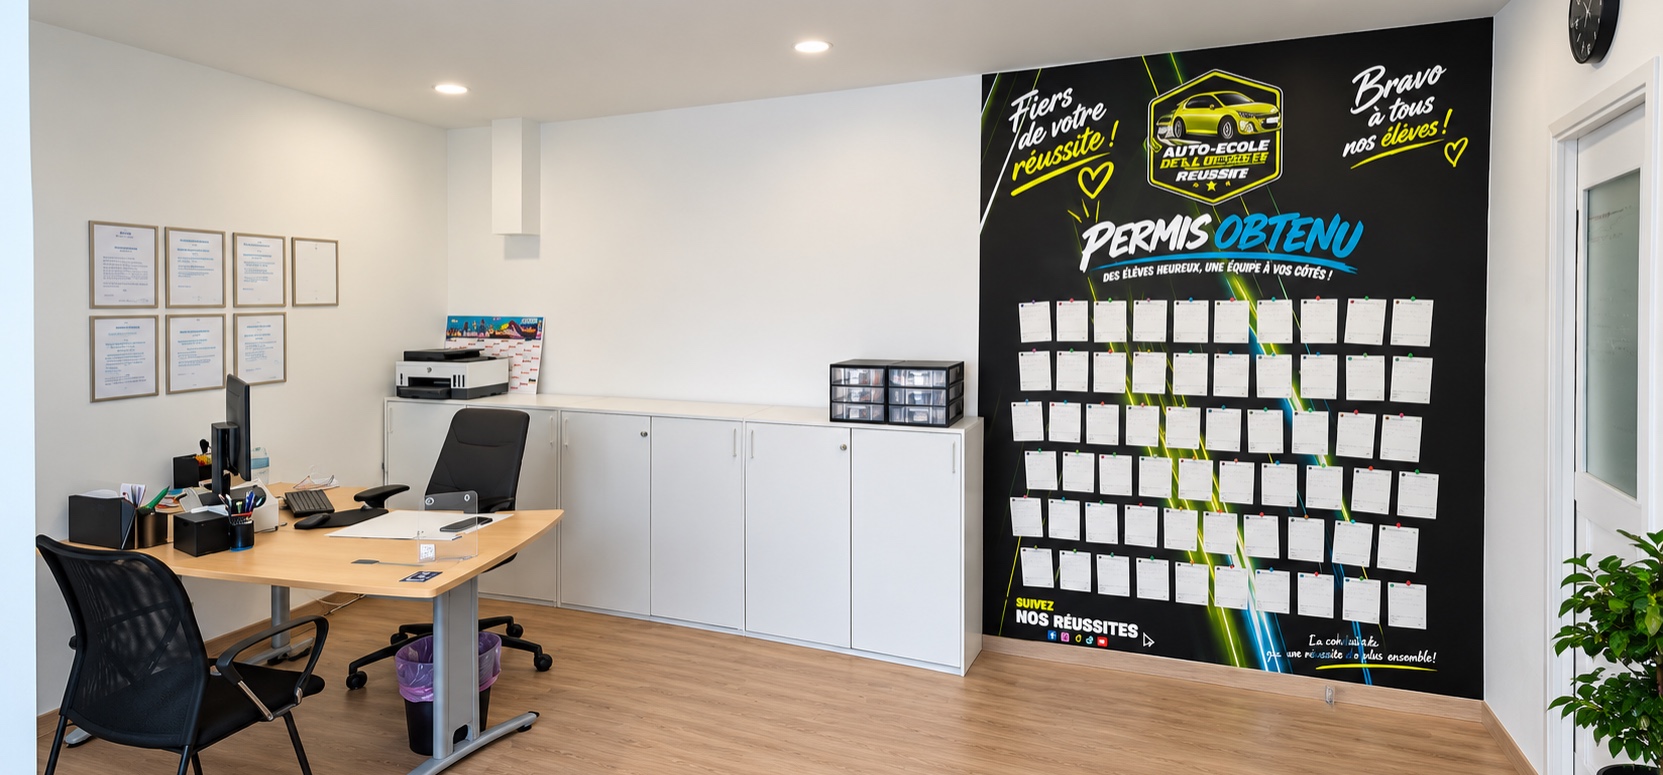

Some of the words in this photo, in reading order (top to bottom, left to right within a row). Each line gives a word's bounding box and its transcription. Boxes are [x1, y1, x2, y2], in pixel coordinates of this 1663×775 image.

[1350, 64, 1447, 115] Bravo
[1008, 87, 1073, 133] Fiers
[1367, 105, 1386, 127] à
[1388, 96, 1435, 122] tous
[1018, 121, 1047, 150] de
[1051, 102, 1107, 138] votre
[1012, 126, 1105, 181] réussite
[1162, 139, 1271, 158] AUTO-ECOLE
[1342, 134, 1377, 158] nos
[1079, 213, 1212, 273] PERMIS
[1214, 212, 1364, 258] OBTENU
[1103, 271, 1121, 283] DES
[1156, 262, 1202, 274] HEUREUX,
[1205, 262, 1224, 272] UNE
[1227, 259, 1262, 275] ÉQUIPE
[1272, 264, 1292, 276] VOS
[1016, 597, 1054, 611] SUIVEZ
[1016, 609, 1049, 627] NOS
[1053, 613, 1139, 638] RÉUSSITES
